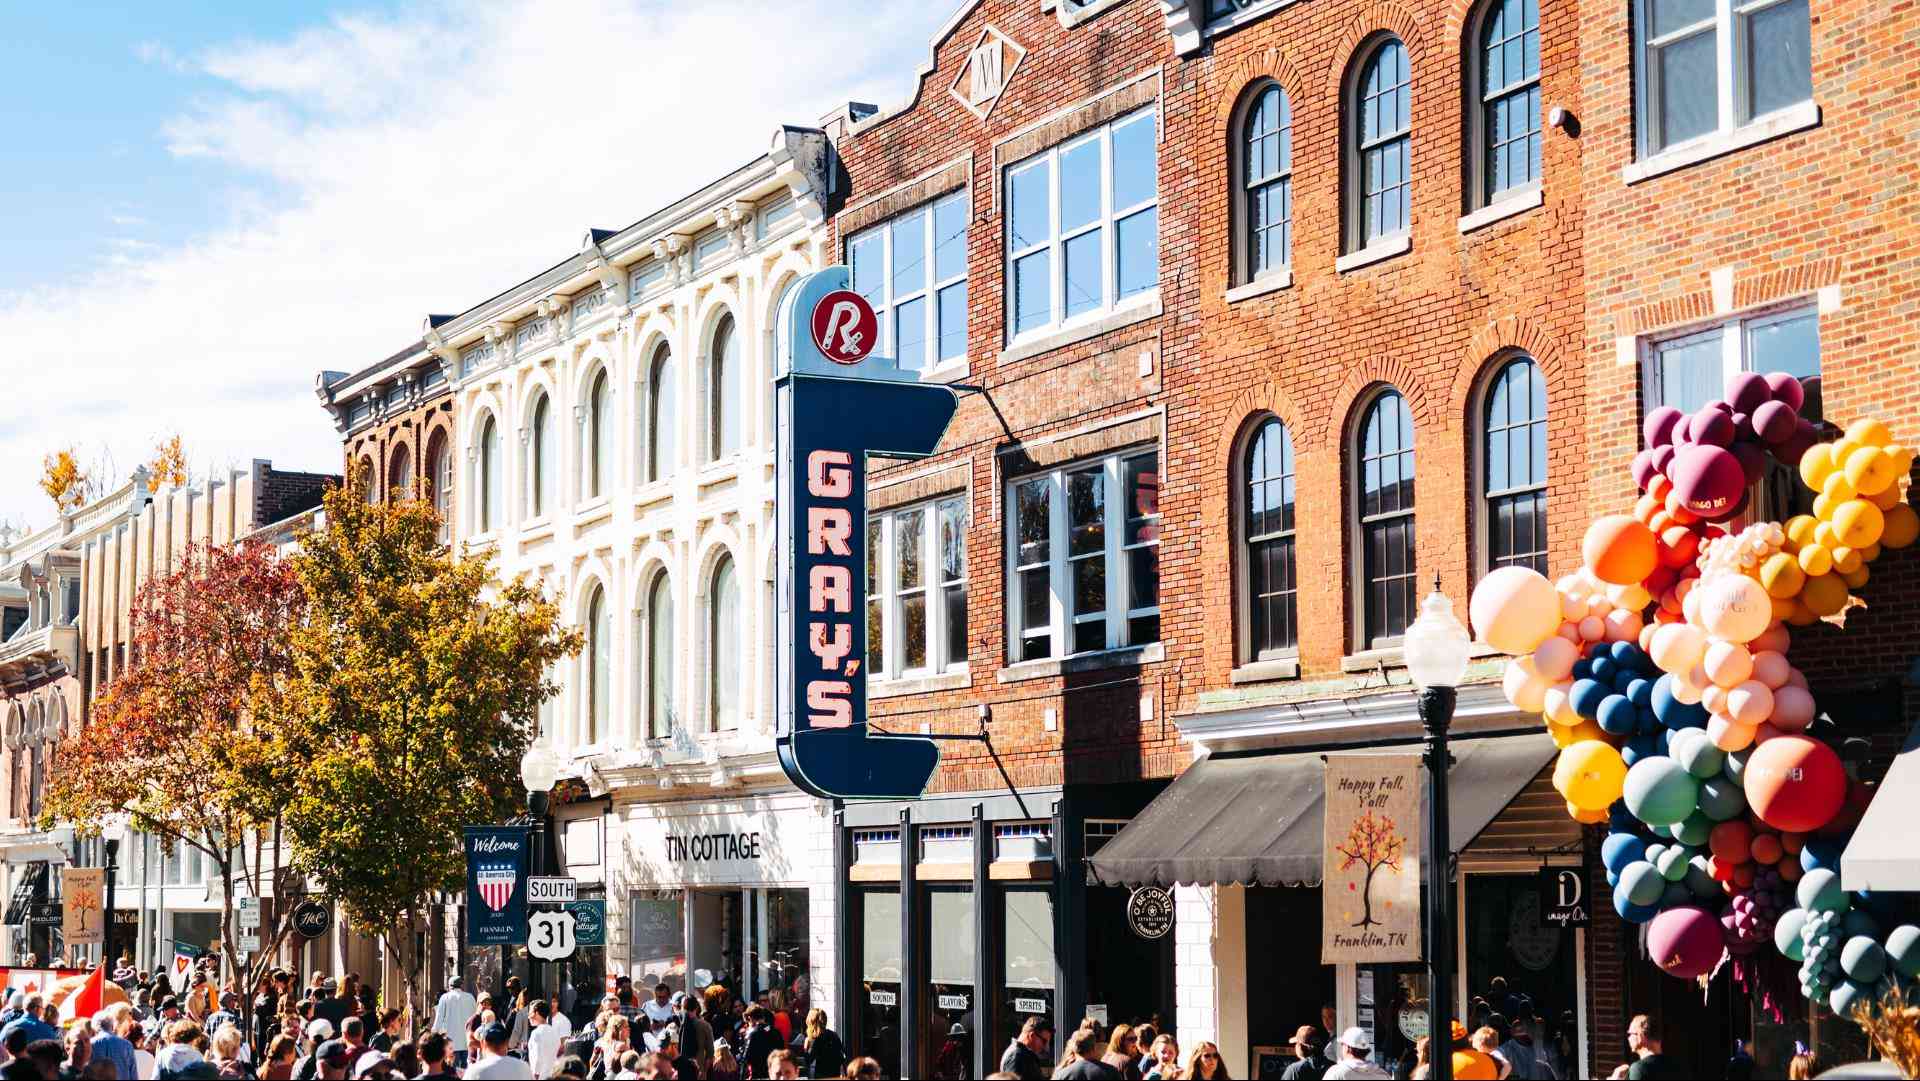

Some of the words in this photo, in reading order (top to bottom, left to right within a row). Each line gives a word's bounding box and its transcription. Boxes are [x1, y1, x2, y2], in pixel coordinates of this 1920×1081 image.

[807, 450, 860, 728] GRAY'S
[1338, 776, 1376, 794] Happy
[1359, 792, 1389, 808] Y'all!
[473, 835, 520, 854] Welcome
[665, 835, 688, 861] TIN
[691, 832, 760, 861] COTTAGE
[531, 881, 574, 897] SOUTH
[1136, 894, 1146, 905] BE
[1146, 890, 1171, 914] JOYFUL
[577, 912, 591, 922] Tin
[537, 920, 565, 949] 31
[576, 923, 599, 933] ottage
[940, 997, 966, 1009] FLAVORS
[1018, 1000, 1043, 1011] SPIRITS
